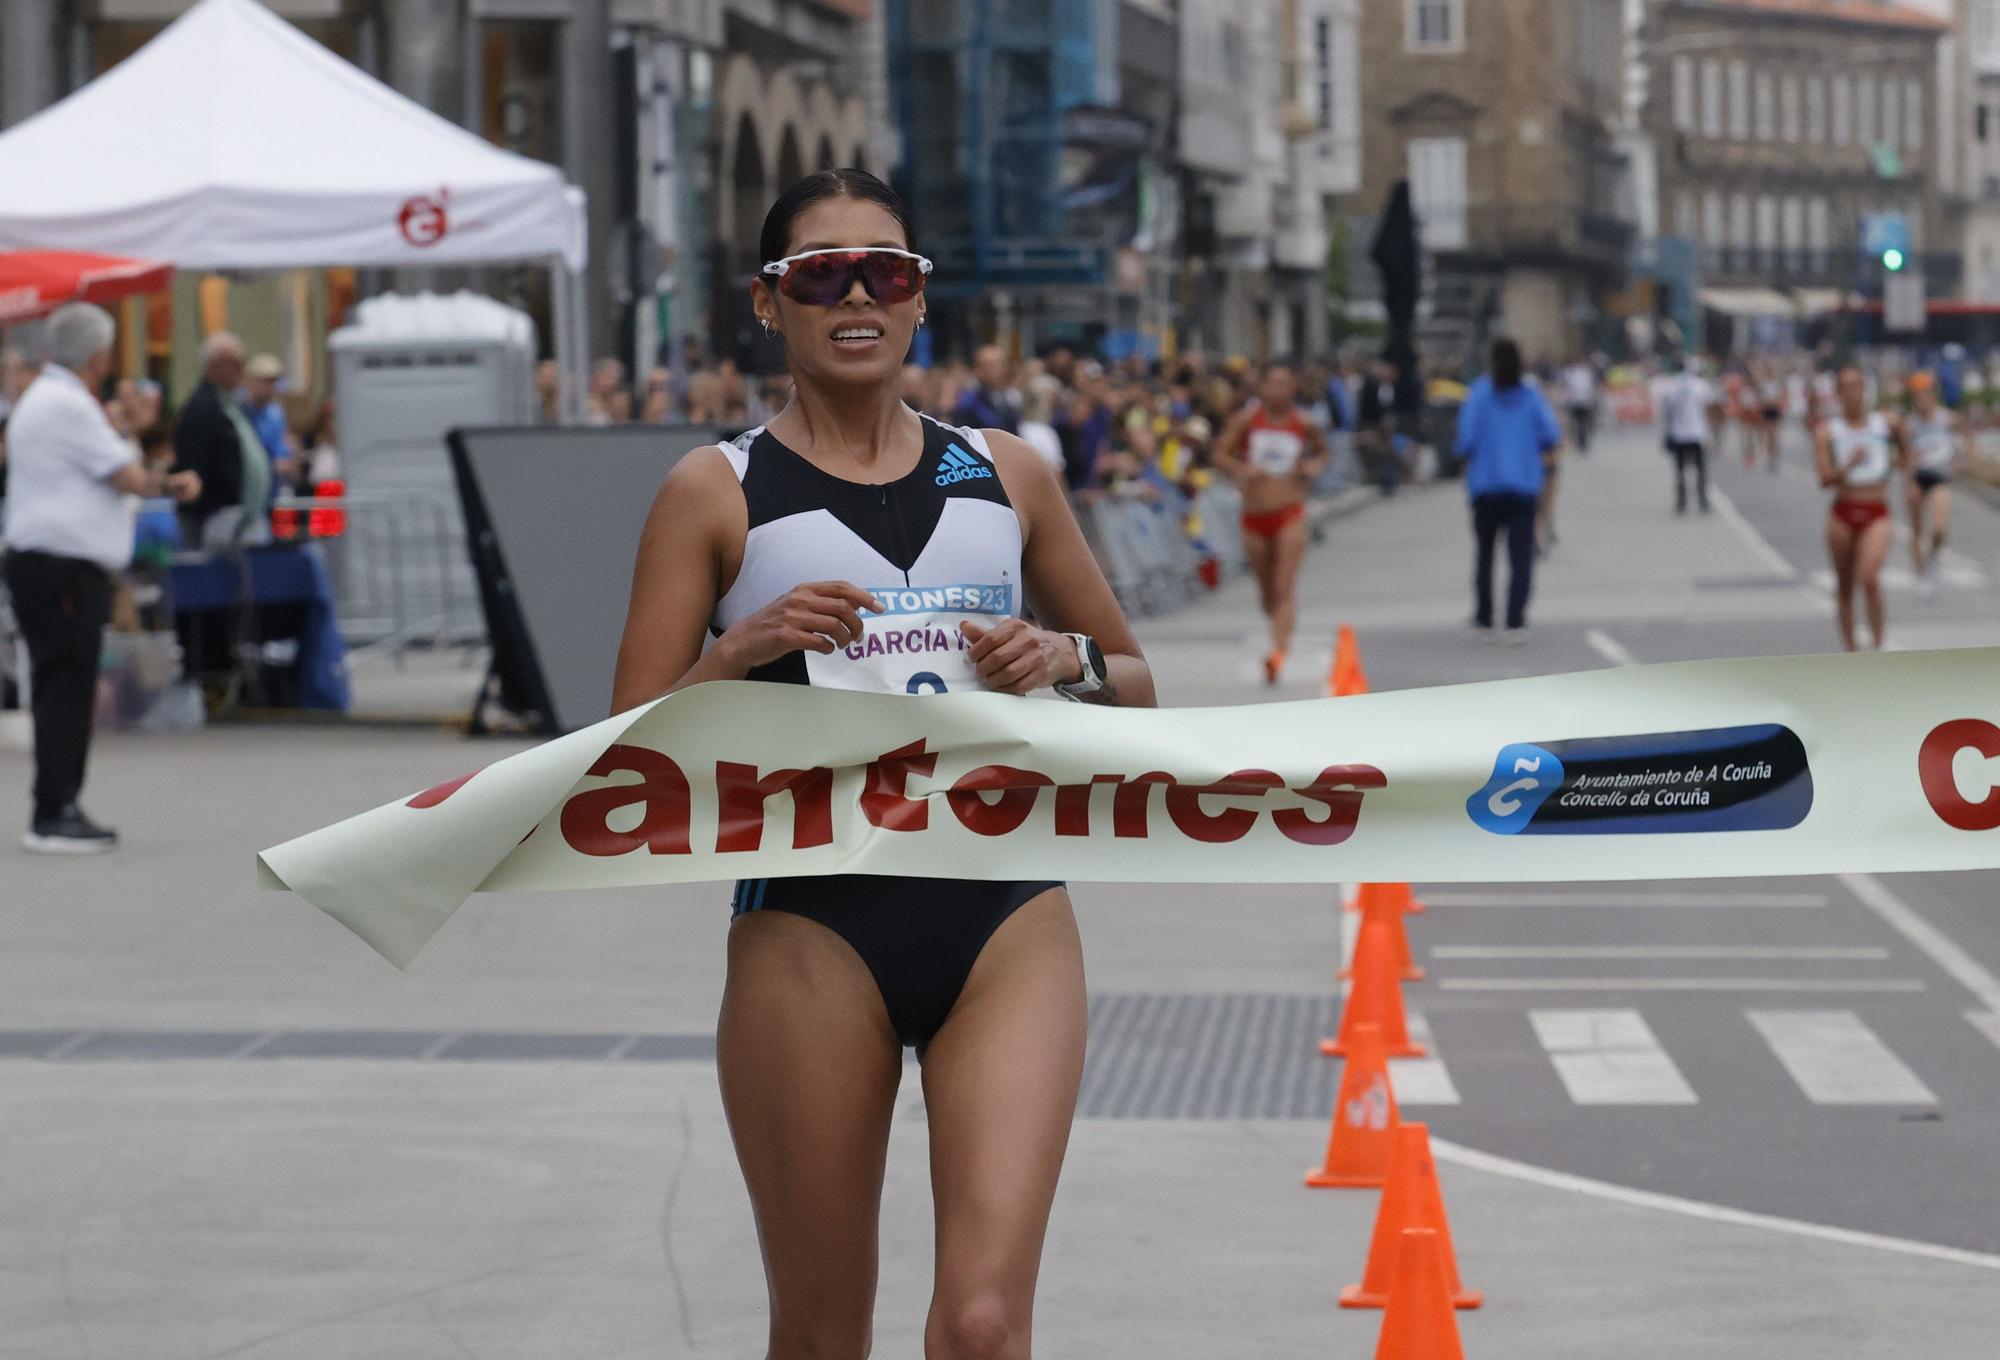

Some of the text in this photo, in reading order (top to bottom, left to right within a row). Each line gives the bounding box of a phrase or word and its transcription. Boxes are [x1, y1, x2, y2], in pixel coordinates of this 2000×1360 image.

[935, 465, 993, 487] adidas
[859, 587, 1006, 615] TONES23
[1571, 761, 1772, 791] Ayuntamiento de A Coruña
[1560, 788, 1710, 807] Concello da Coruña
